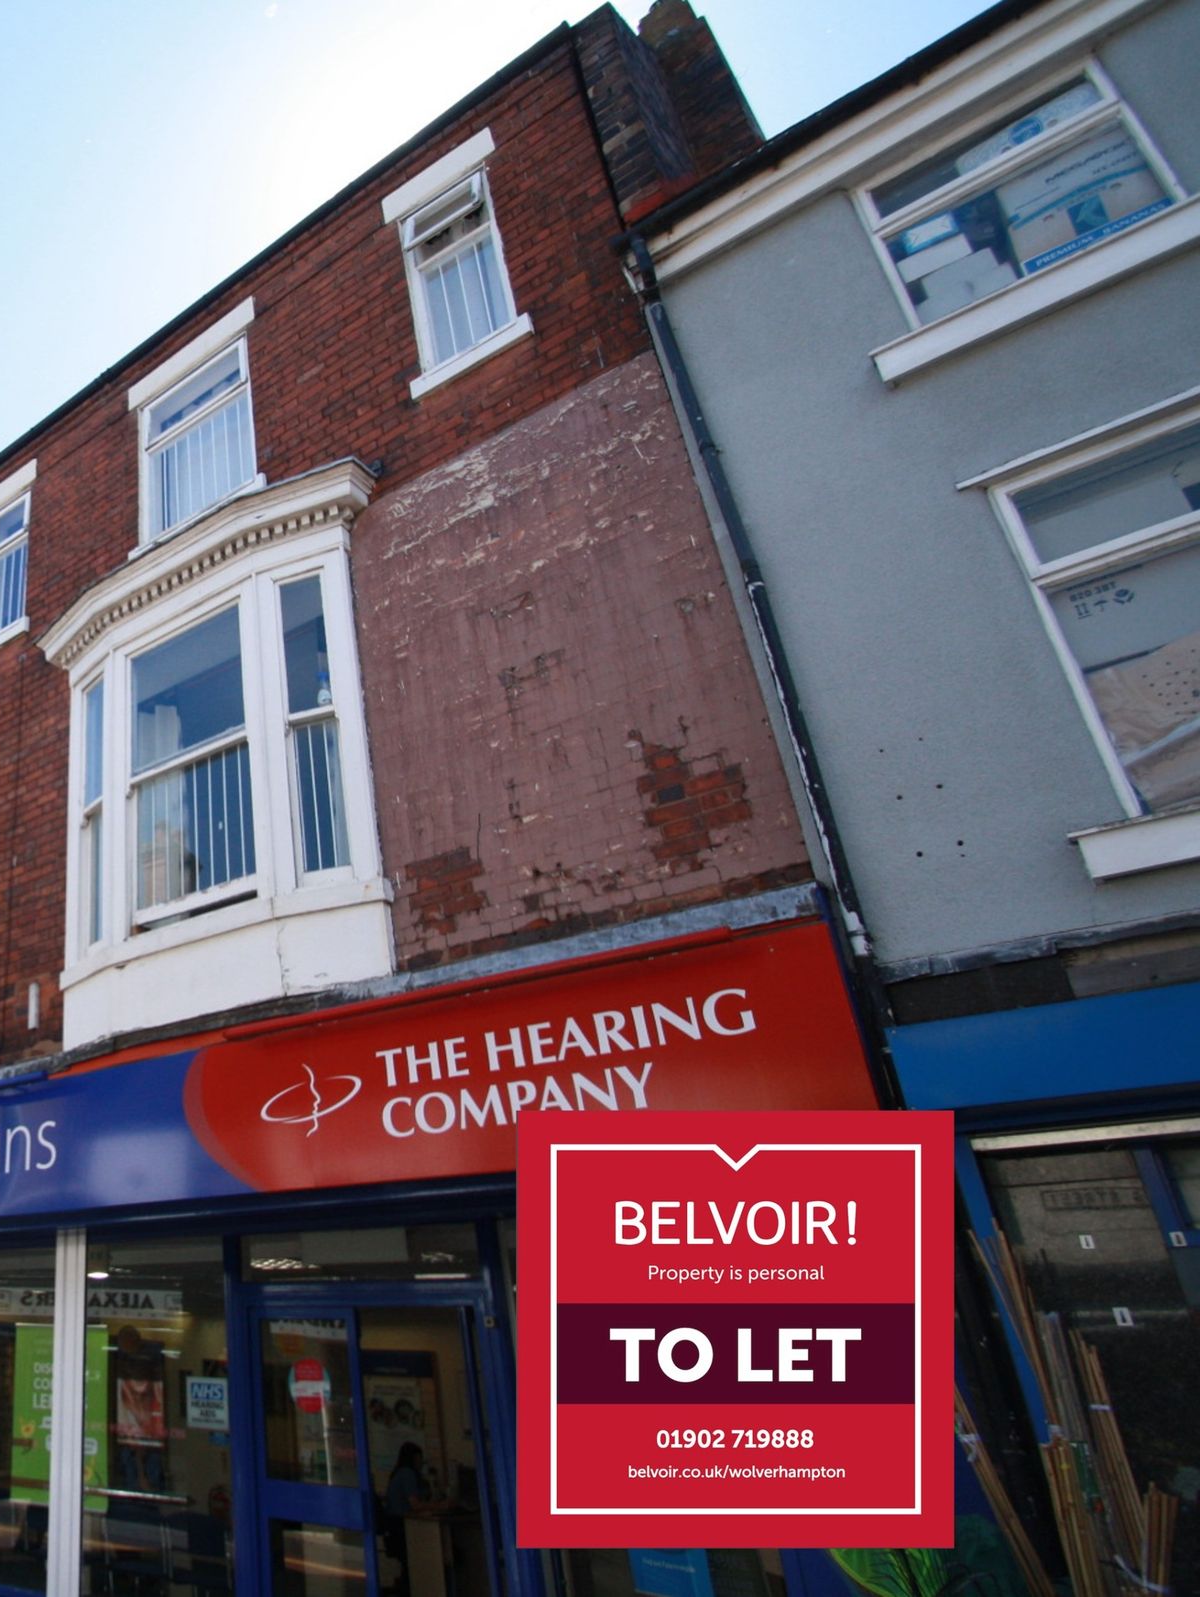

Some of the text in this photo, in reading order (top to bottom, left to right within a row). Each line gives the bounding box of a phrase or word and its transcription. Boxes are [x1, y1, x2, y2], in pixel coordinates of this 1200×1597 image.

[1034, 201, 1167, 268] PREMIUM BANANAS
[375, 987, 758, 1088] THE HEARING
[381, 1062, 654, 1139] COMPANY
[191, 1383, 224, 1400] NHS
